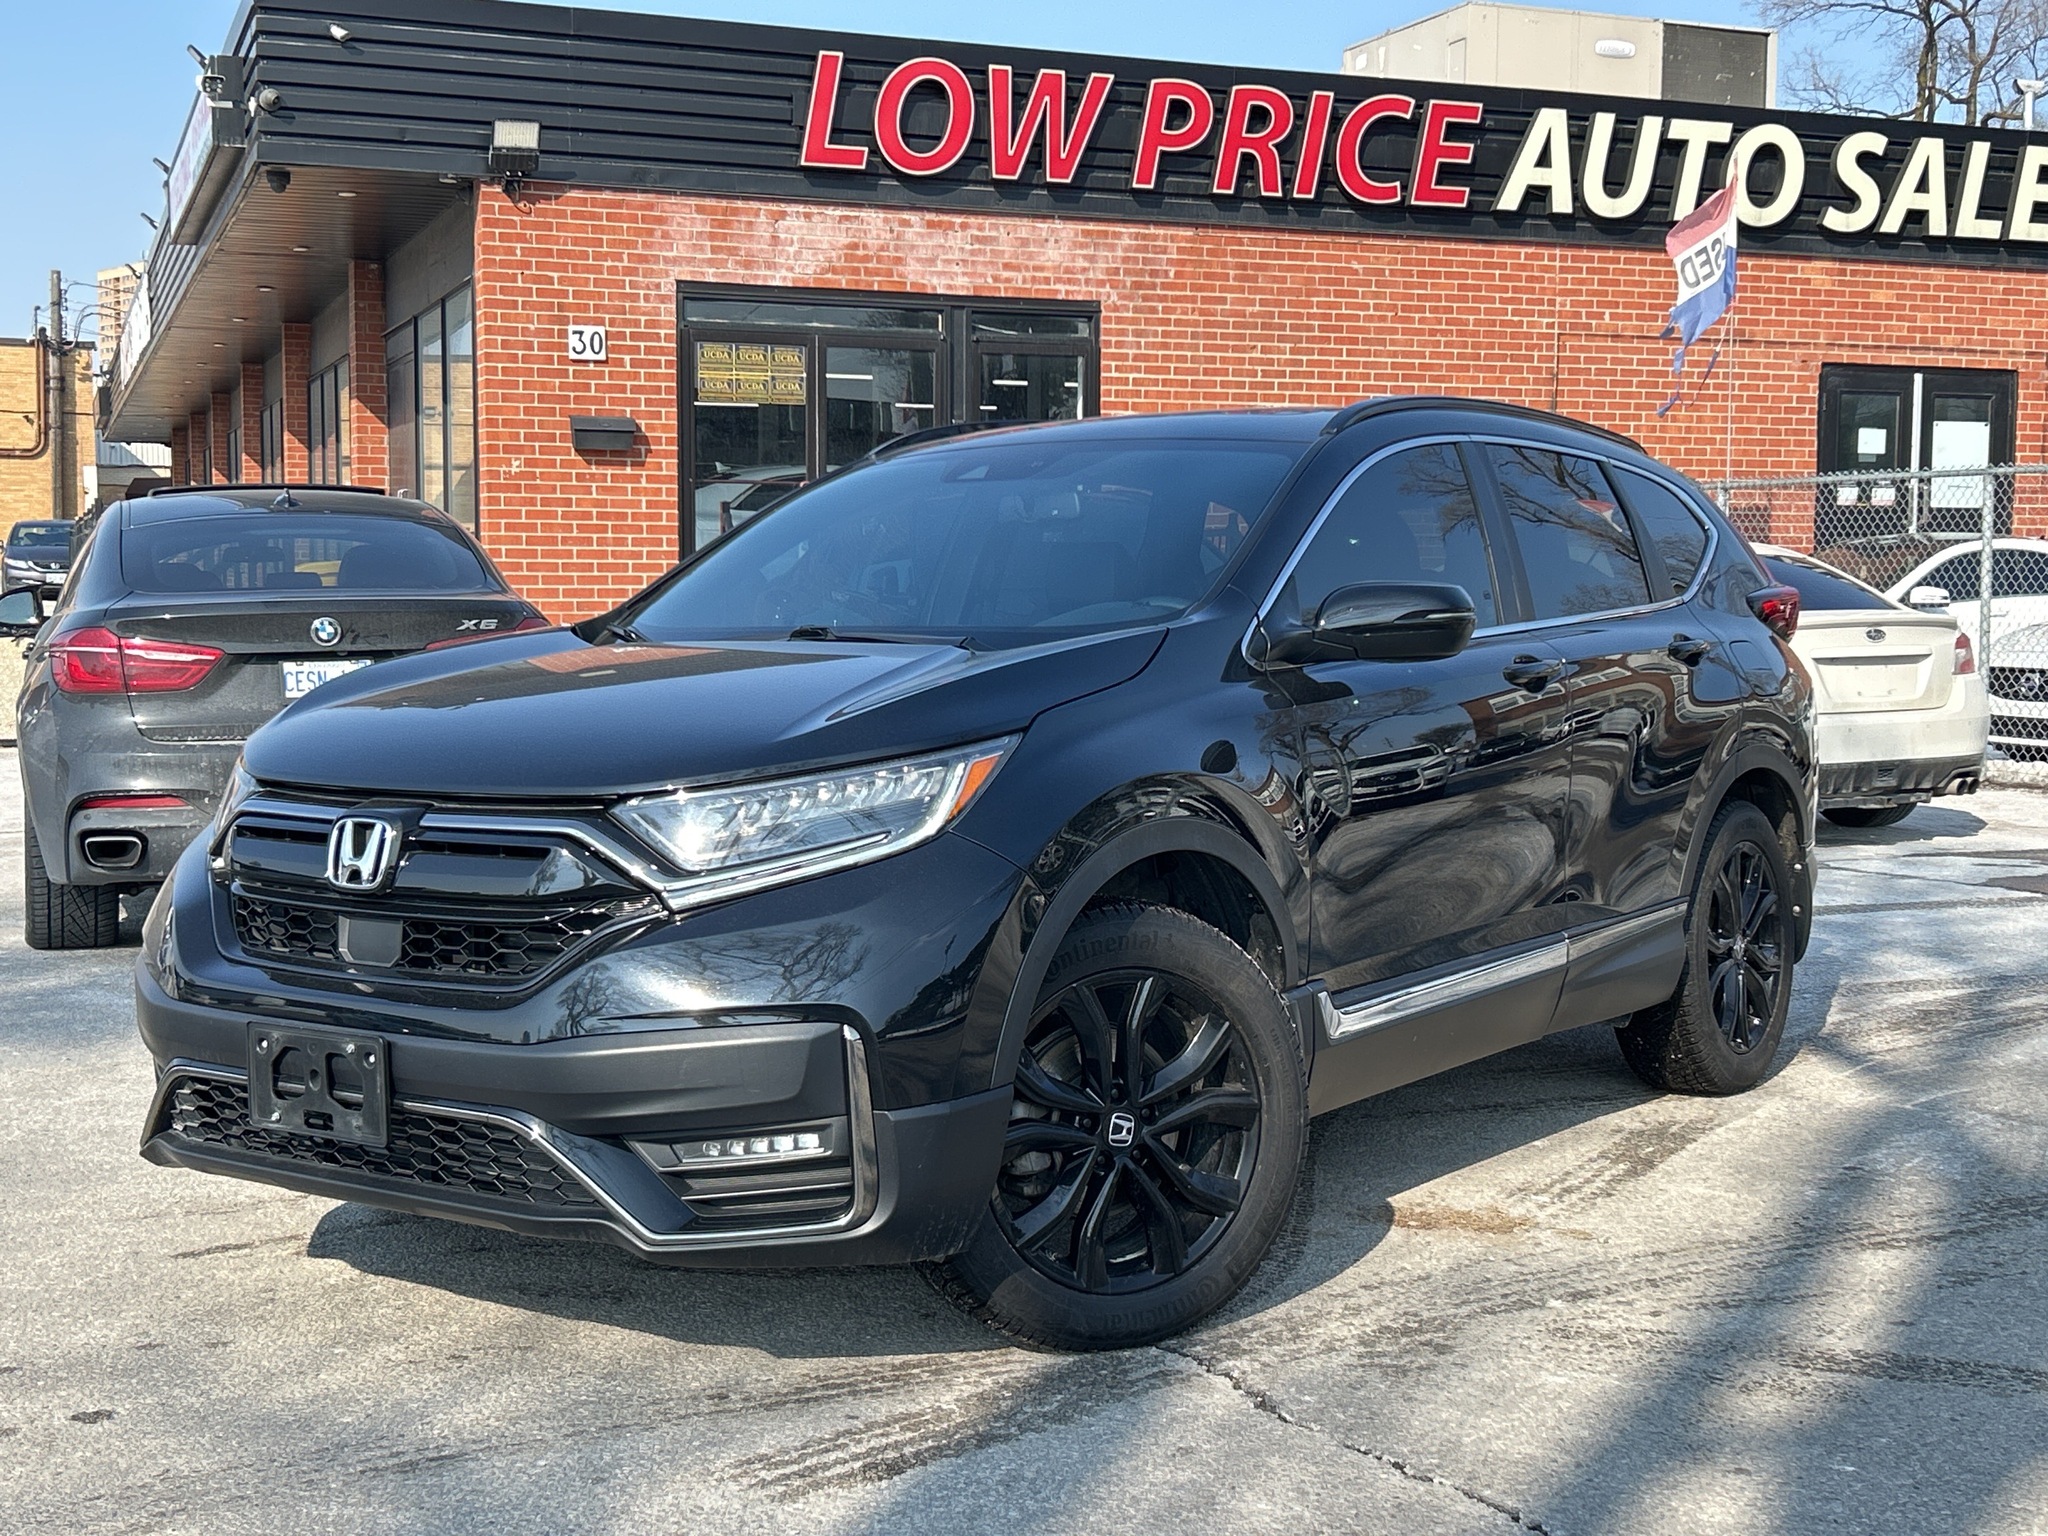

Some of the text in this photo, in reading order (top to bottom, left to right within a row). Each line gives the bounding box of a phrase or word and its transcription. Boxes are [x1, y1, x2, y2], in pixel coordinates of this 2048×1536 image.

[801, 50, 2048, 242] LOW PRICE AUTO SALE
[572, 330, 603, 355] 30
[703, 351, 729, 359] UCDA
[740, 352, 765, 361] UCDA
[774, 354, 800, 363] UCDA
[704, 381, 729, 389] UCDA
[740, 382, 765, 391] UCDA
[775, 382, 800, 391] UCDA
[456, 619, 498, 630] X6
